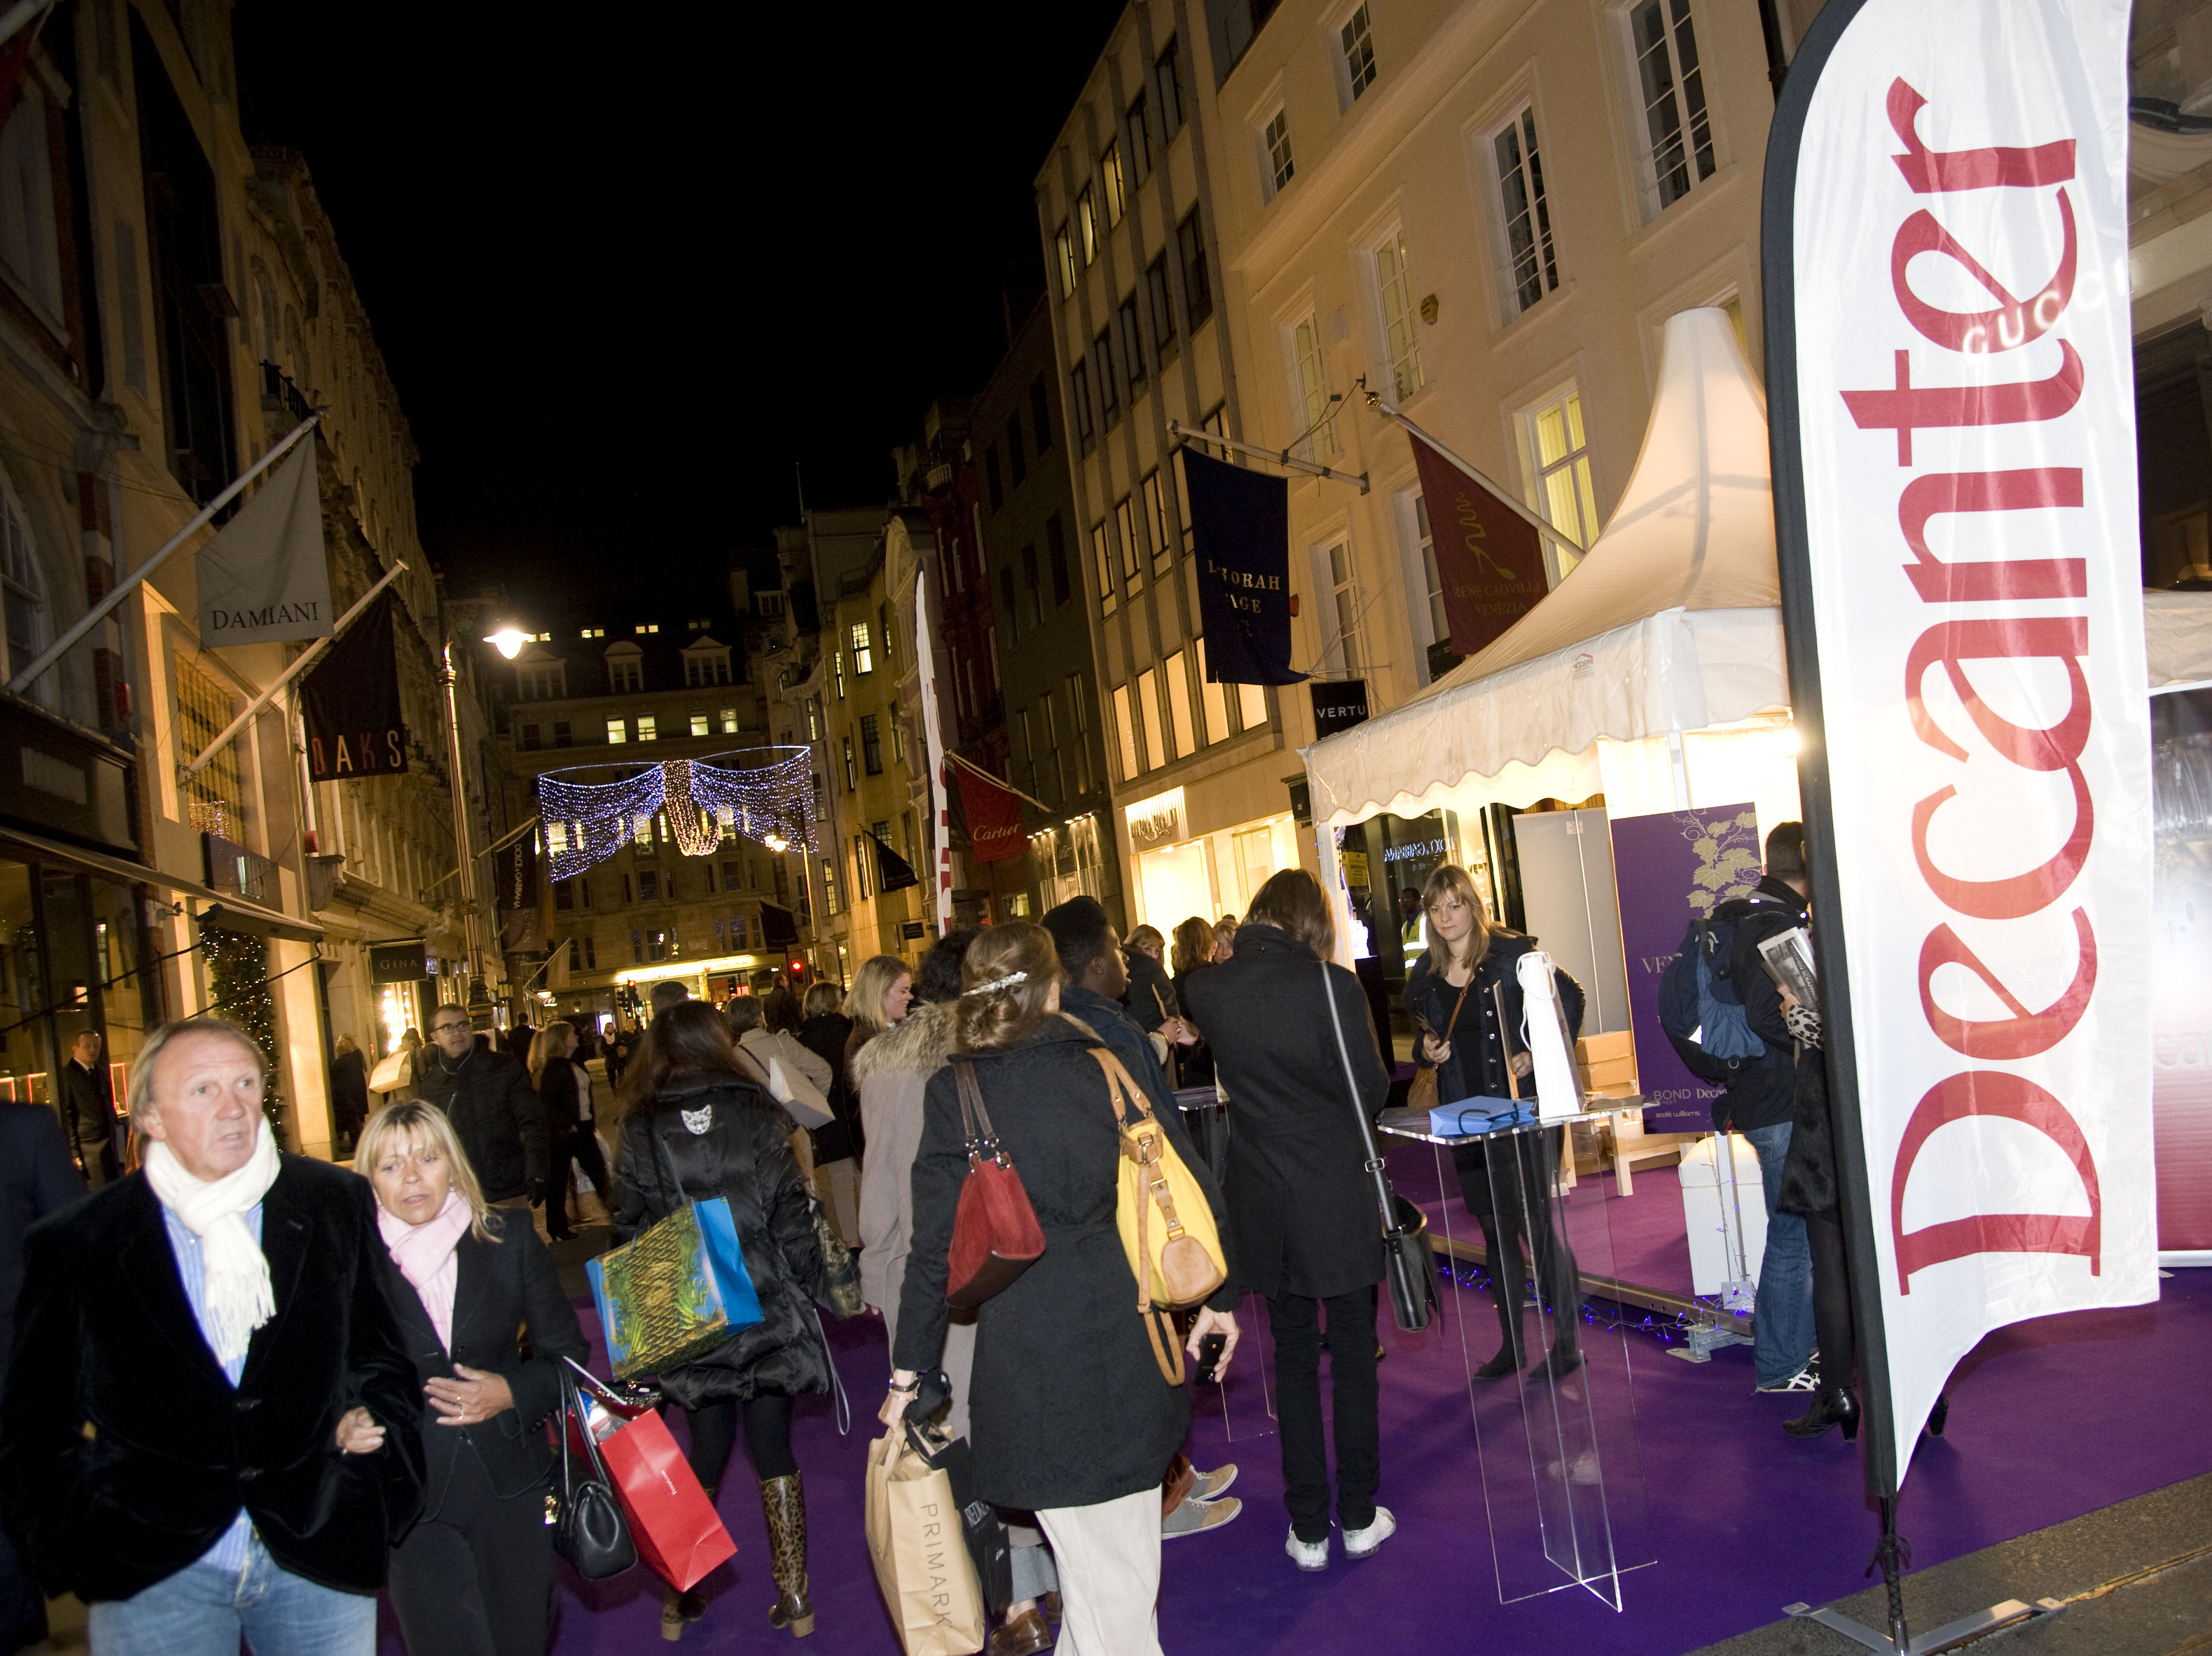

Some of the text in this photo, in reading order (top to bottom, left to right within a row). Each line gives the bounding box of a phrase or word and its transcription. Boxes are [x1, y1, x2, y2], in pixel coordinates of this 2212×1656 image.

[212, 602, 320, 630] DAMIANI
[1473, 601, 1528, 616] VENEZIA
[1839, 75, 2101, 1296] Decanter
[1316, 705, 1366, 719] VERTU
[311, 730, 402, 775] DAKS
[973, 822, 1021, 841] Cartier
[380, 958, 418, 970] GINA
[1654, 1089, 1691, 1101] BOND
[920, 1503, 953, 1626] PRIMARK
